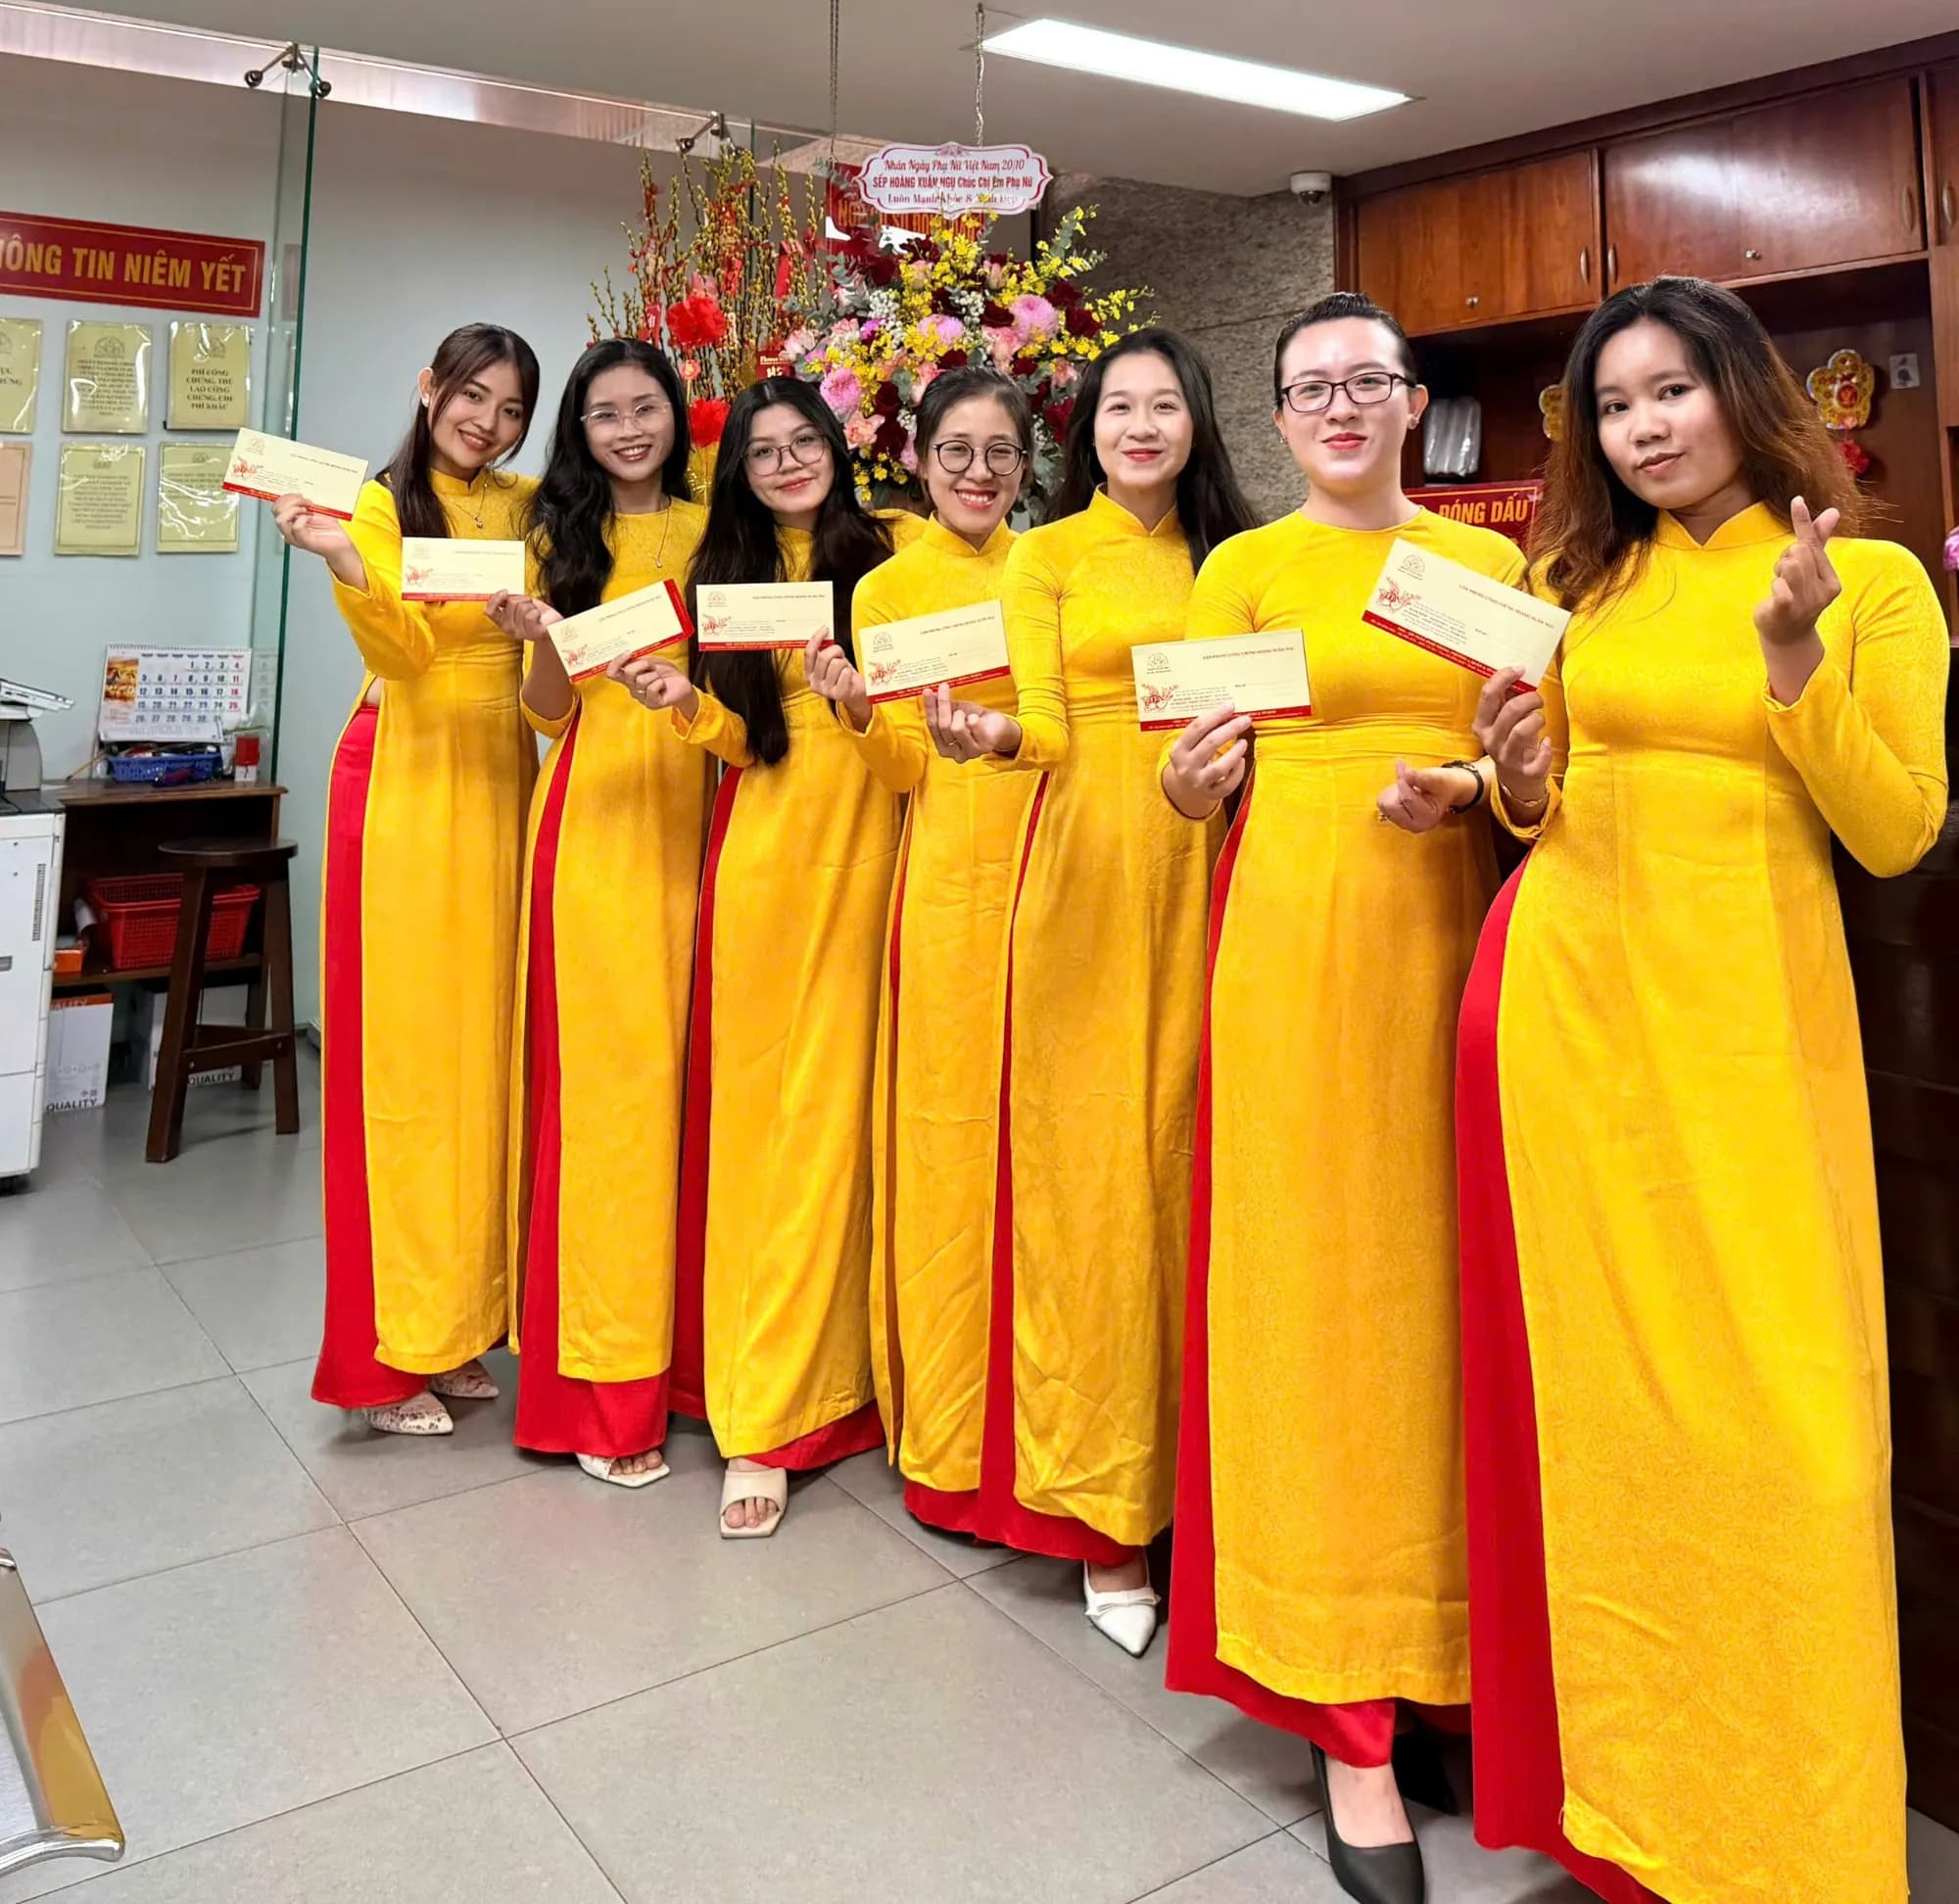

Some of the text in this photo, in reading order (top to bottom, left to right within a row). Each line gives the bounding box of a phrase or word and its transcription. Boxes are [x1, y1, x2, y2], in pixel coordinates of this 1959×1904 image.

[909, 159, 931, 173] Ngày
[932, 160, 948, 173] Phụ
[980, 159, 1000, 172] Nam
[1002, 159, 1026, 172] 20/10
[889, 174, 916, 189] HOÀNG
[918, 174, 938, 189] XUÂN
[957, 175, 977, 189] Chúc
[978, 176, 990, 190] Chị
[992, 176, 1004, 189] Em
[1006, 176, 1021, 191] Phụ
[0, 233, 246, 294] ÔNG TIN NIÊM YẾT
[1490, 492, 1529, 524] DẤU
[189, 1072, 235, 1085] QUALITY
[46, 1098, 98, 1112] QUALITY
